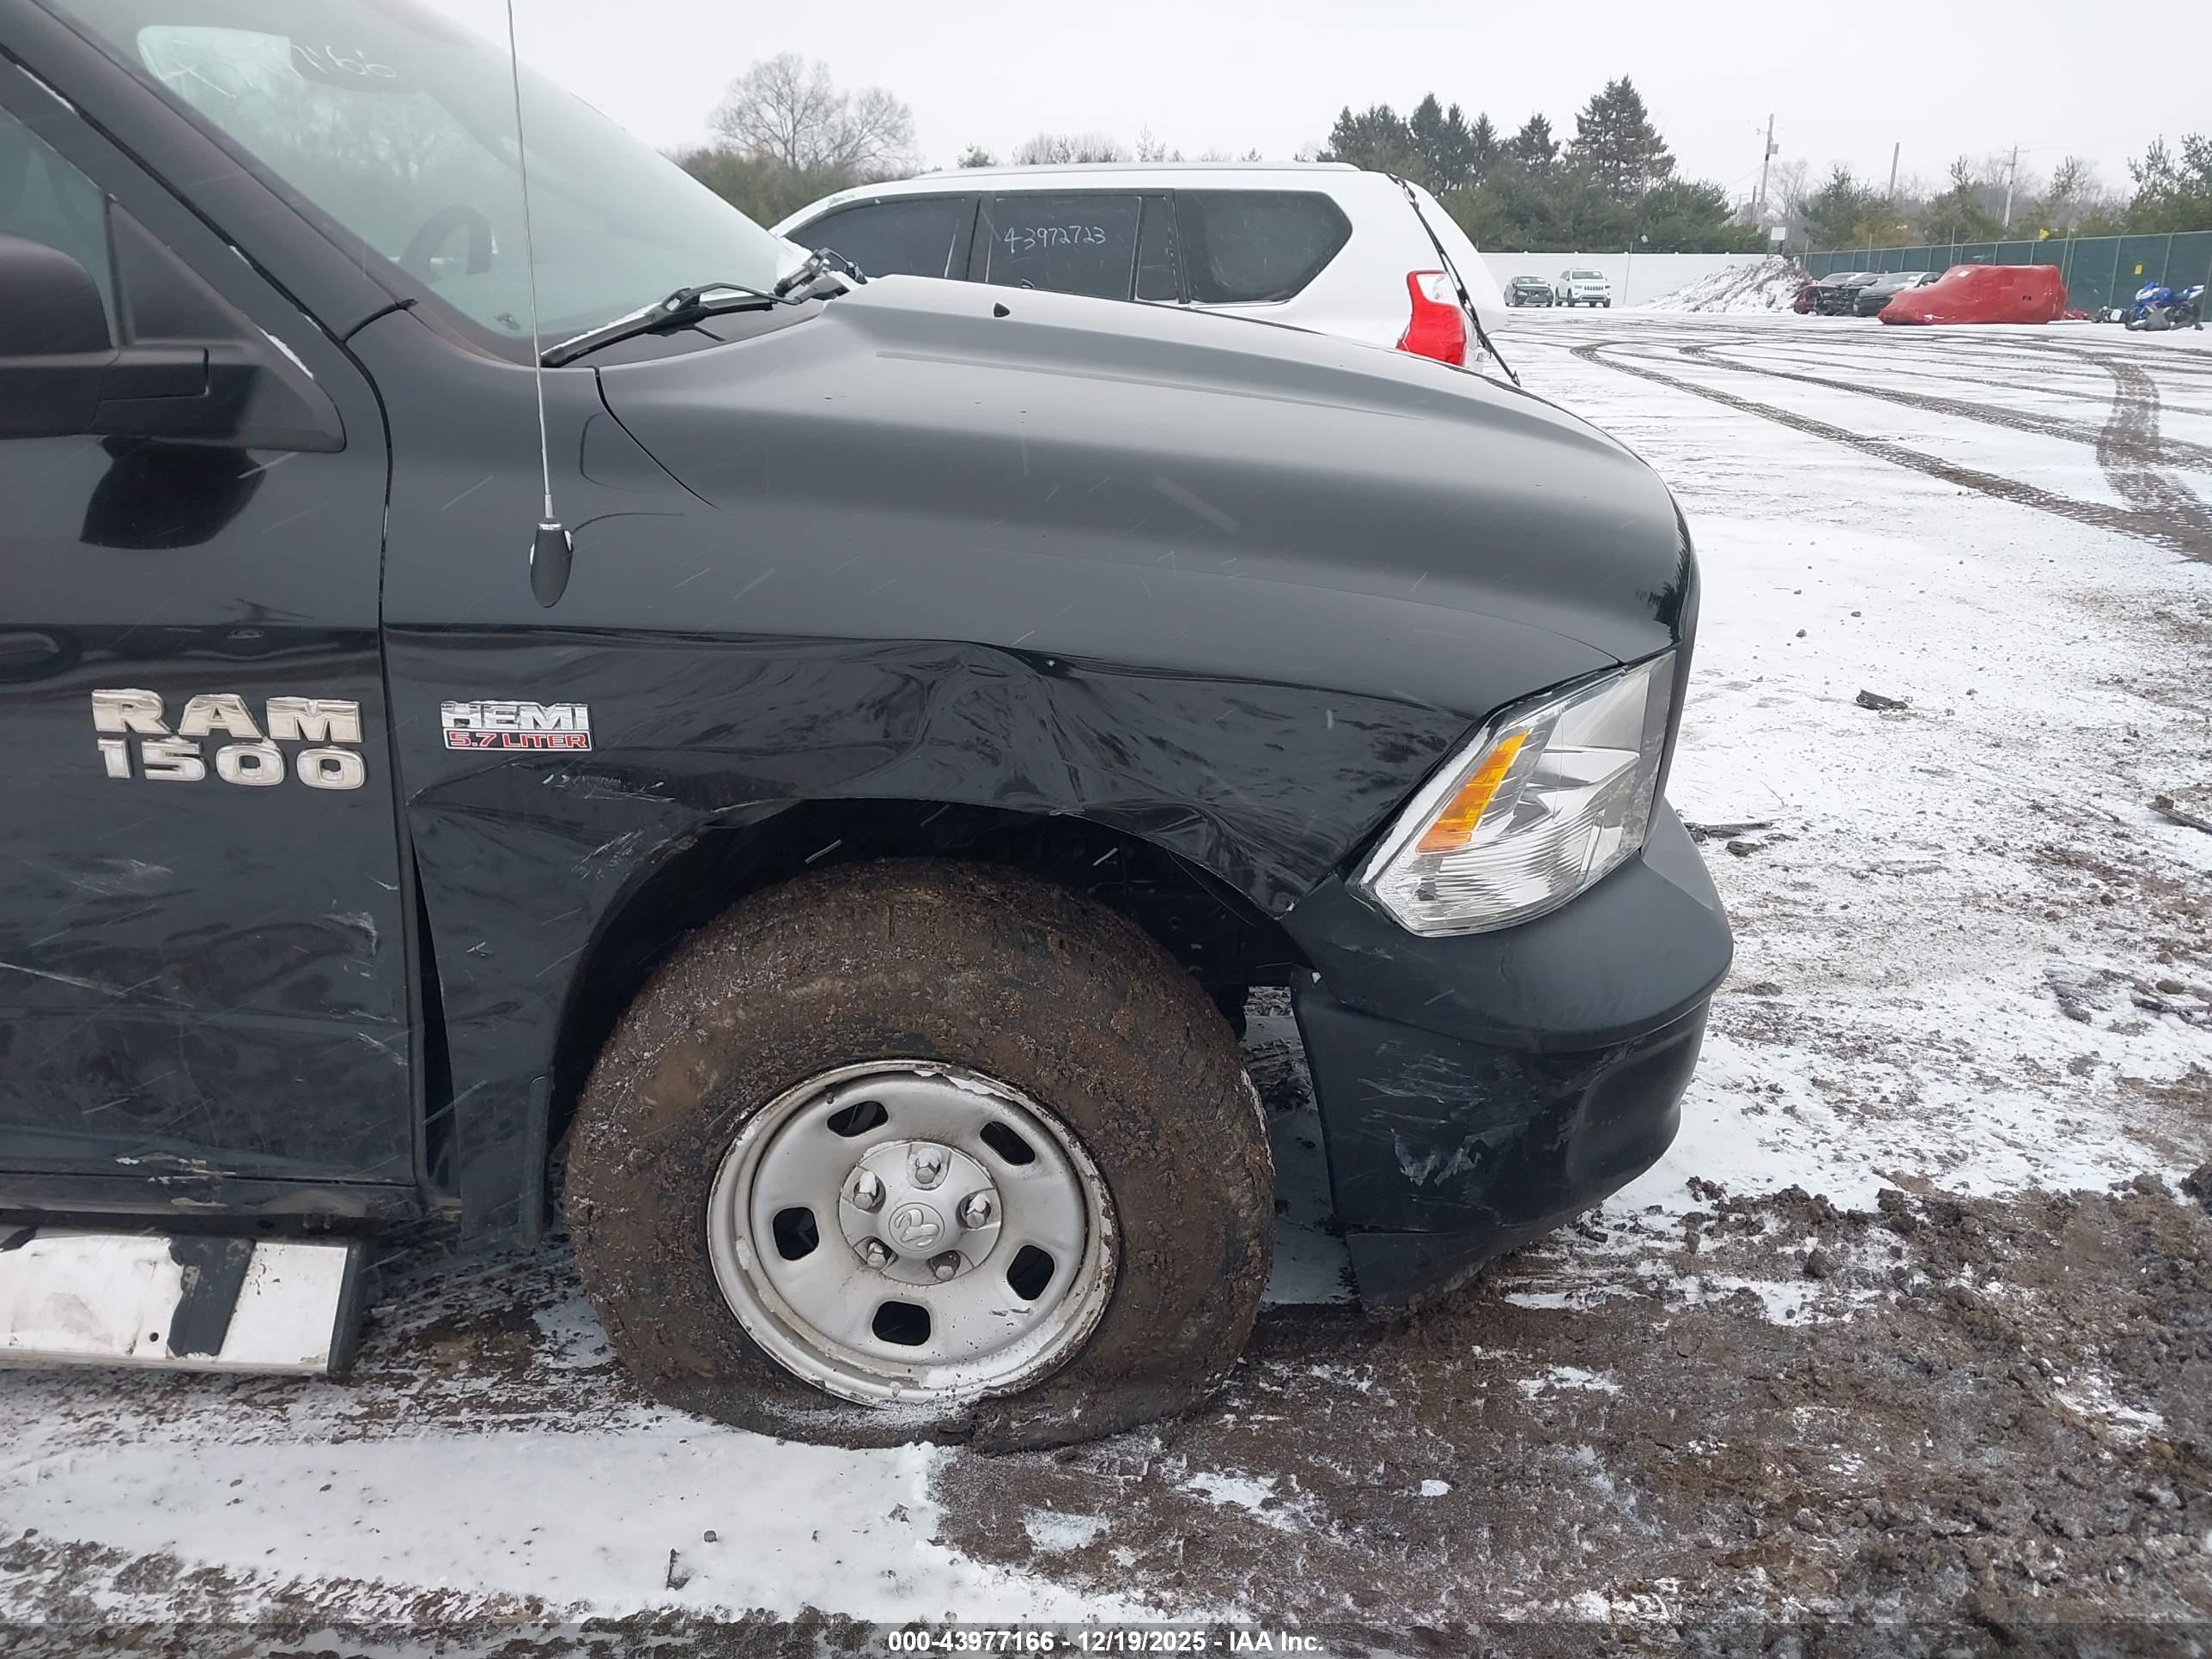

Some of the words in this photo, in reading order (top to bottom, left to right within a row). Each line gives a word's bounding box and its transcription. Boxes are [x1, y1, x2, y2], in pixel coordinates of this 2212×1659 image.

[1004, 225, 1107, 254] 43972723
[91, 689, 363, 742] RAM
[440, 700, 590, 730] HEMI
[448, 732, 497, 747] 5.7
[501, 733, 588, 748] LITER
[96, 737, 368, 790] 1500
